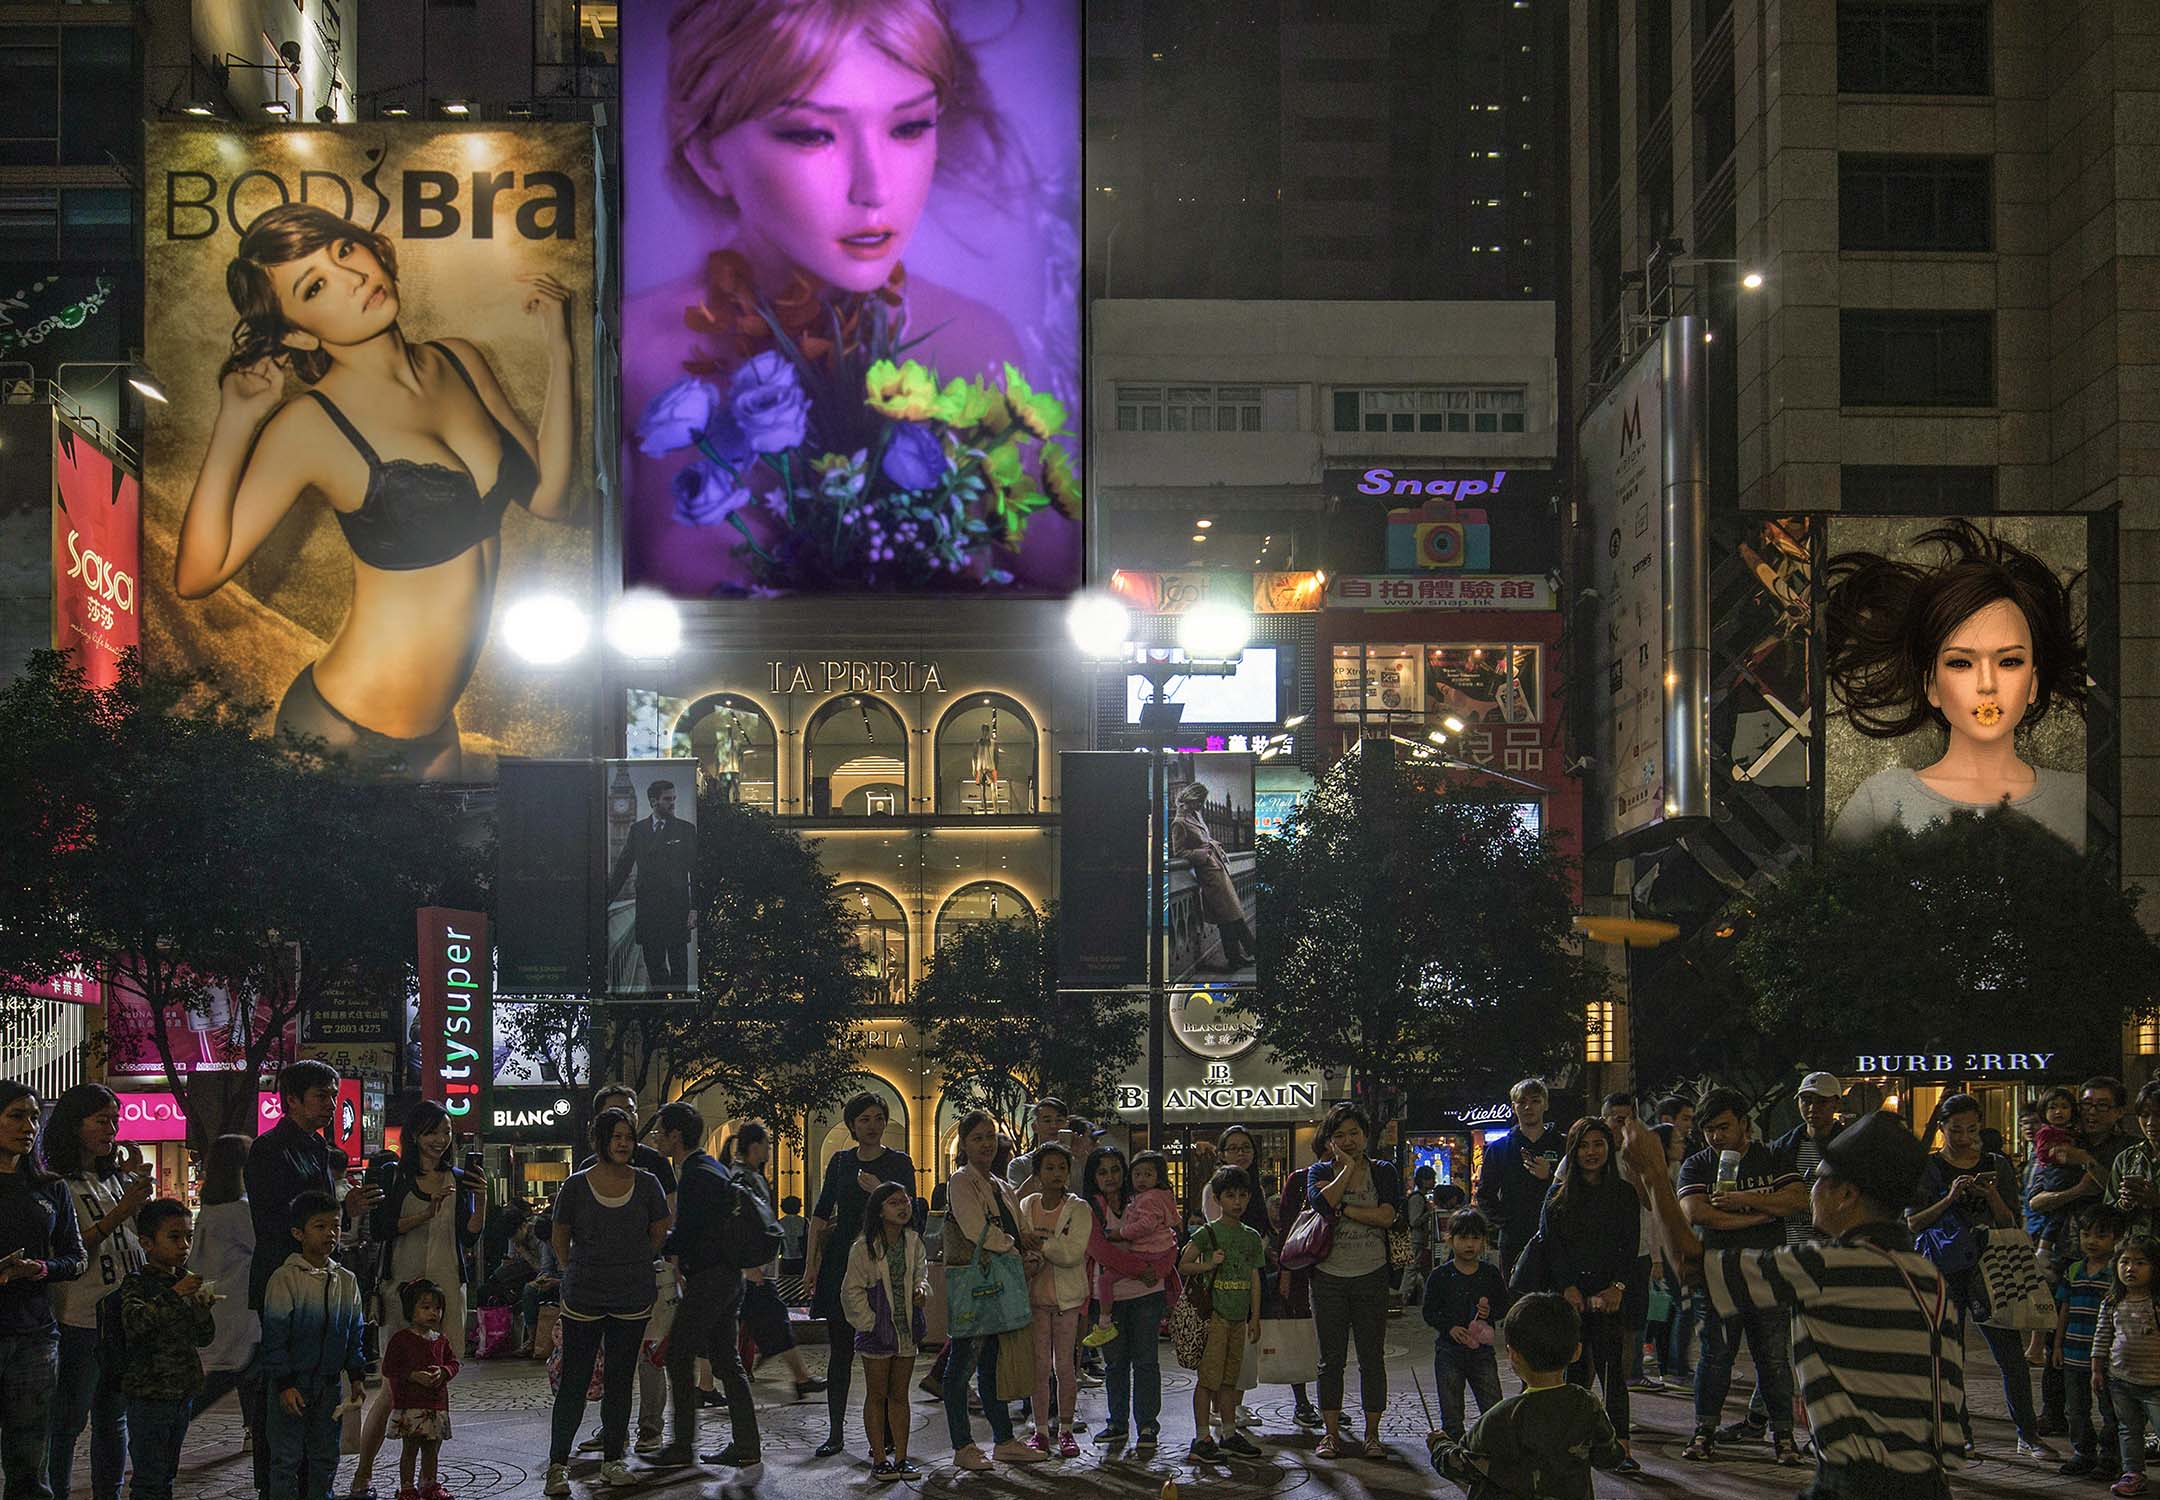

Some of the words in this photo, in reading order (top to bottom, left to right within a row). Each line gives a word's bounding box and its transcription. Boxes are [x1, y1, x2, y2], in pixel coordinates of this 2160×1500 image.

[402, 170, 577, 240] Bra
[1357, 467, 1508, 502] Snap!
[1339, 579, 1537, 600] 自拍體驗館
[1384, 599, 1492, 607] www.snap.hk
[493, 1110, 555, 1127] BLANC
[1457, 1103, 1513, 1122] Kiehl's
